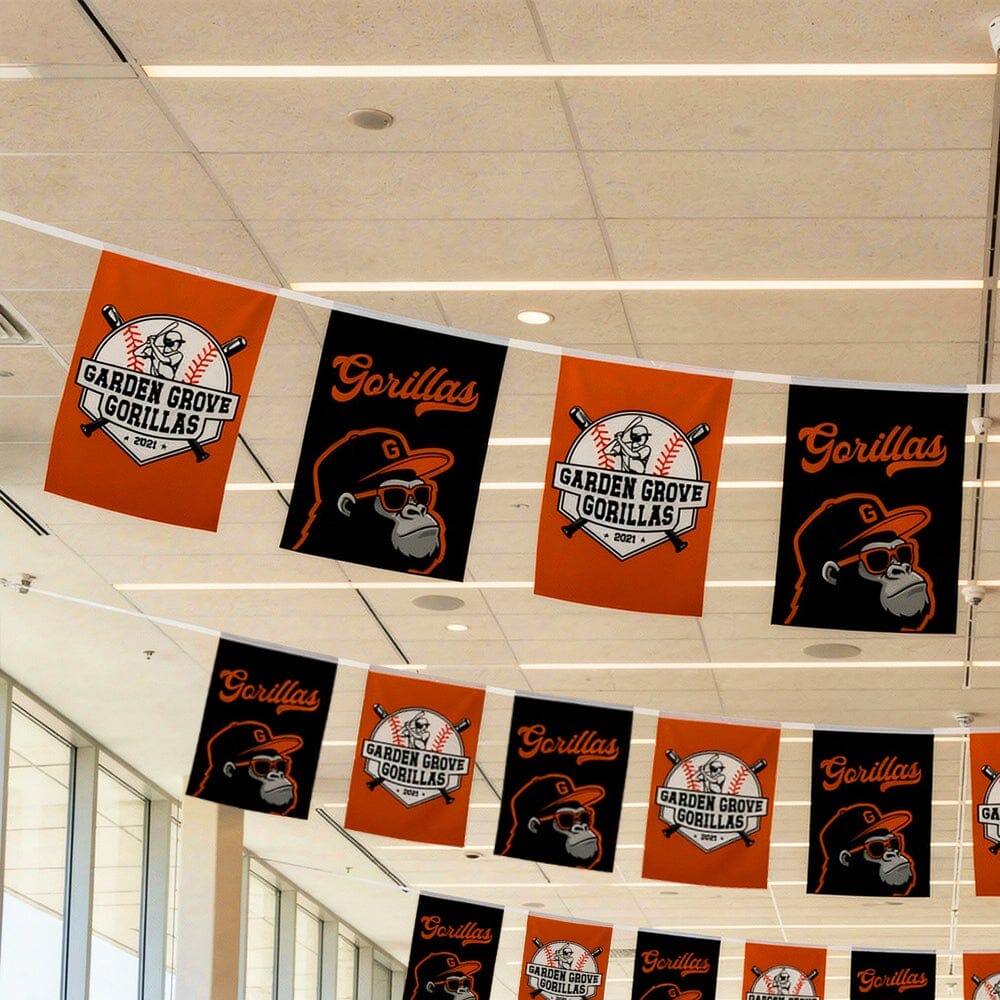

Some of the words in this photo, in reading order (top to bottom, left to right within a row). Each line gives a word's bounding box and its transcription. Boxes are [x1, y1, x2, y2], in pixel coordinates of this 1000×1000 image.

[84, 364, 165, 406] GARDEN
[167, 385, 234, 415] GROVE
[331, 353, 479, 416] Gorillas
[105, 395, 201, 436] GORILLAS
[132, 436, 158, 451] 2021
[381, 439, 401, 460] G
[798, 422, 947, 477] Gorillas
[560, 467, 637, 501] GARDEN
[641, 479, 705, 503] GROVE
[583, 495, 675, 529] GORILLAS
[857, 502, 878, 524] G
[613, 532, 637, 545] 2021
[219, 669, 320, 714] Gorillas
[253, 727, 267, 742] G
[517, 724, 619, 765] Gorillas
[366, 742, 420, 768] GARDEN
[422, 753, 467, 772] GROVE
[381, 762, 447, 787] GORILLAS
[820, 756, 922, 792] Gorillas
[554, 780, 569, 796] G
[659, 789, 717, 812] GARDEN
[719, 796, 765, 814] GROVE
[677, 808, 745, 831] GORILLAS
[861, 809, 877, 825] G
[421, 916, 492, 946] Gorillas
[528, 964, 567, 982] GARDEN
[568, 971, 600, 984] GROVE
[642, 950, 710, 977] Gorillas
[539, 978, 586, 996] GORILLAS
[857, 969, 928, 993] Gorillas
